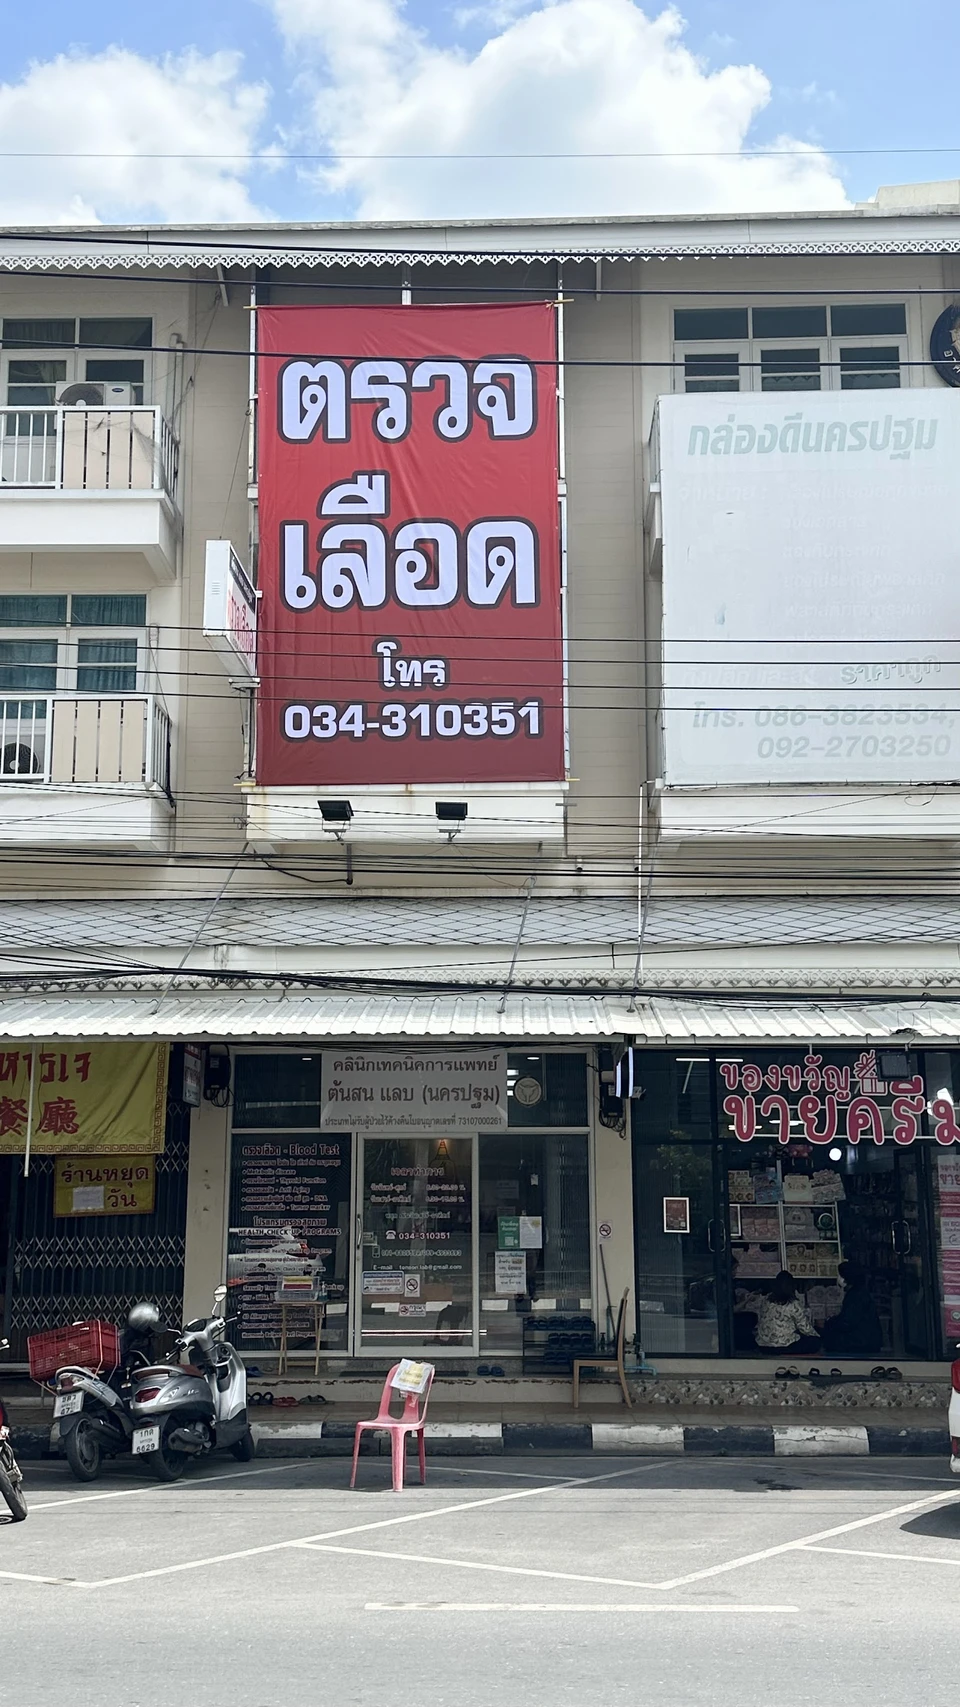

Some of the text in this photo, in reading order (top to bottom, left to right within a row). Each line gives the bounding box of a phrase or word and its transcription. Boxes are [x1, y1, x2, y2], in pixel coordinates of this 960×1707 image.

[279, 358, 535, 442] ตรวจ
[687, 412, 938, 460] กล่องดีนครปฐม
[281, 473, 536, 609] เลือด
[376, 642, 447, 688] โทร
[840, 655, 942, 684] ราคาถูก
[284, 702, 541, 738] 034-310351
[693, 701, 955, 728] โทร. 086-3823534,
[757, 734, 952, 759] 092-2703250
[333, 1054, 501, 1072] คลินิกเทคนิคการแพทย์
[720, 1055, 850, 1101] ของขวัญ
[328, 1080, 501, 1109] ต้นสน แลบ (นครปฐม)
[458, 1116, 502, 1126] 73107000261
[242, 1143, 281, 1156] ตรวจเลือด
[289, 1143, 318, 1156] Blood
[319, 1144, 340, 1156] Test
[61, 1162, 149, 1188] ร้านหยุด
[107, 1189, 138, 1208] วัน
[238, 1228, 342, 1236] HEALTH CHECK UP PROGRAMS
[253, 1216, 327, 1227] โปรแกรมตรวจสุขภาพ
